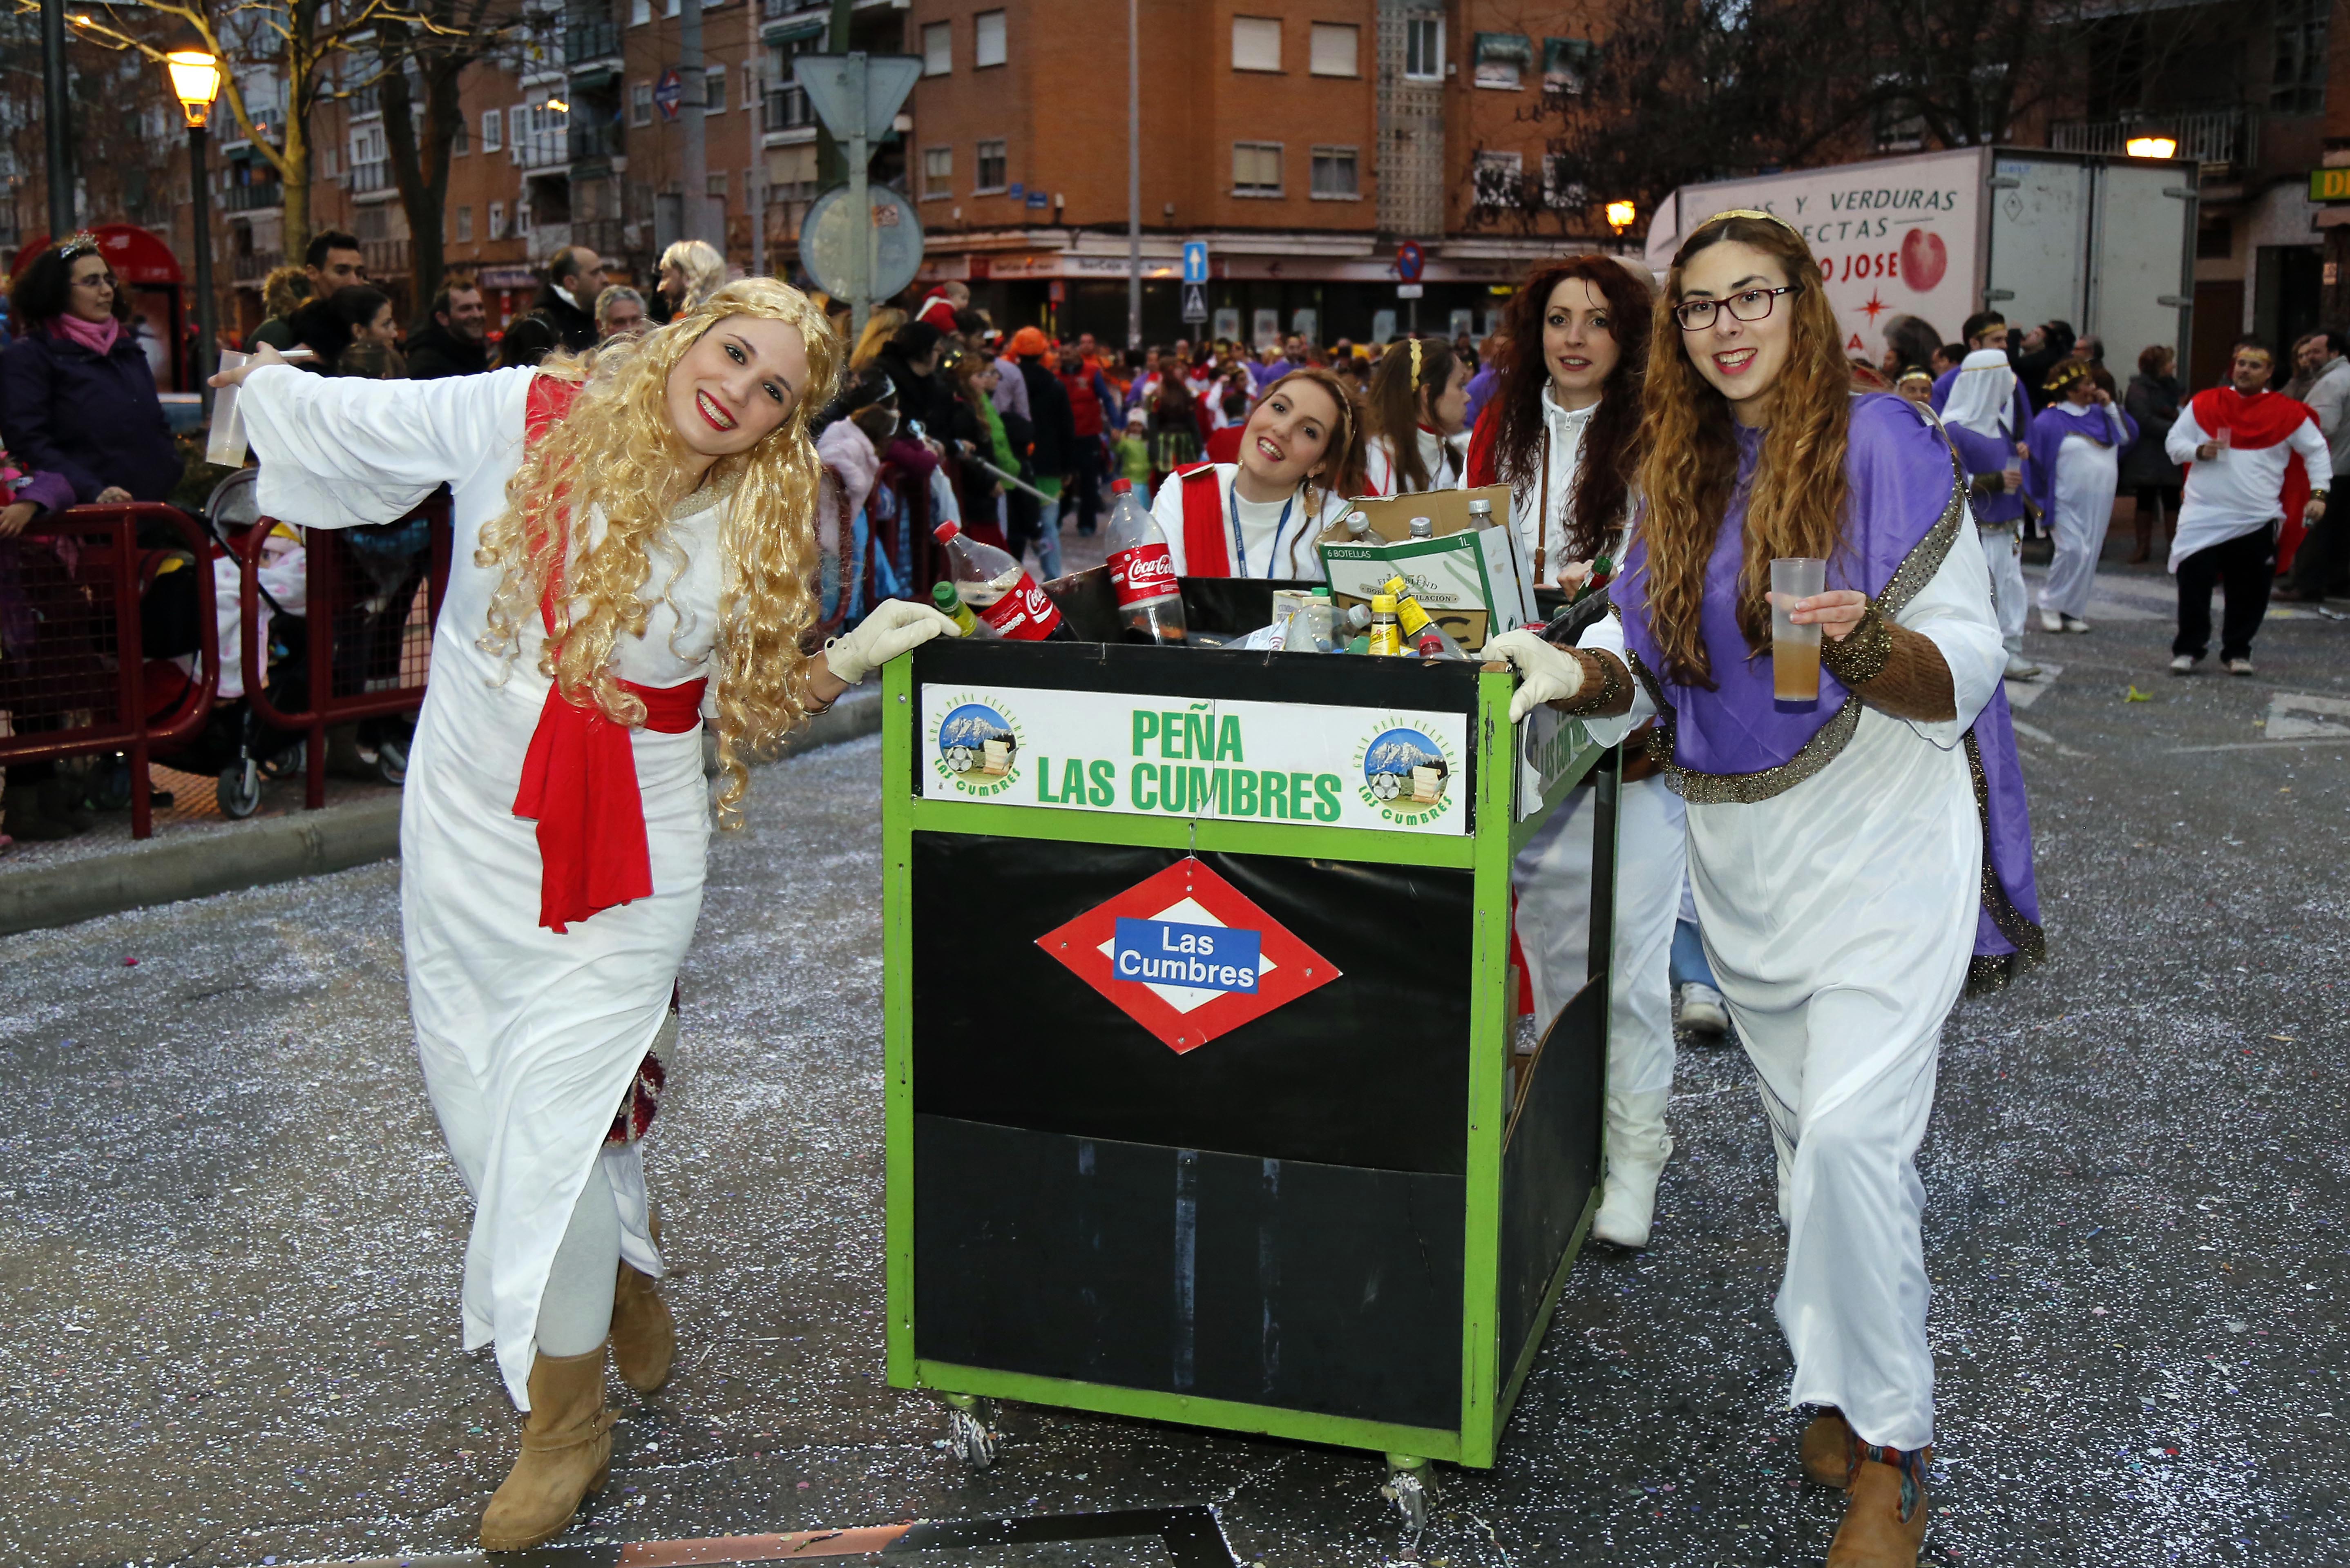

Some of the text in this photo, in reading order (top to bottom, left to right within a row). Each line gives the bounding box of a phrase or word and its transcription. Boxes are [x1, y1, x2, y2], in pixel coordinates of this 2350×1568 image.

[1796, 196, 1808, 214] Y
[1830, 189, 1958, 211] VERDURAS
[1803, 217, 1889, 243] ECTAS
[1841, 252, 1898, 283] JOSE
[1327, 549, 1372, 558] 6 BOTELLAS
[1458, 536, 1470, 547] 1L
[1128, 554, 1175, 581] Coca-Col
[1132, 703, 1244, 762] PEÑA
[934, 758, 1021, 796] LAS CUMBRES
[1038, 756, 1342, 822] LAS CUMBRES
[1358, 785, 1452, 826] LAS CUMBRES
[1162, 926, 1214, 955] Las
[1119, 949, 1255, 988] Cumbres
